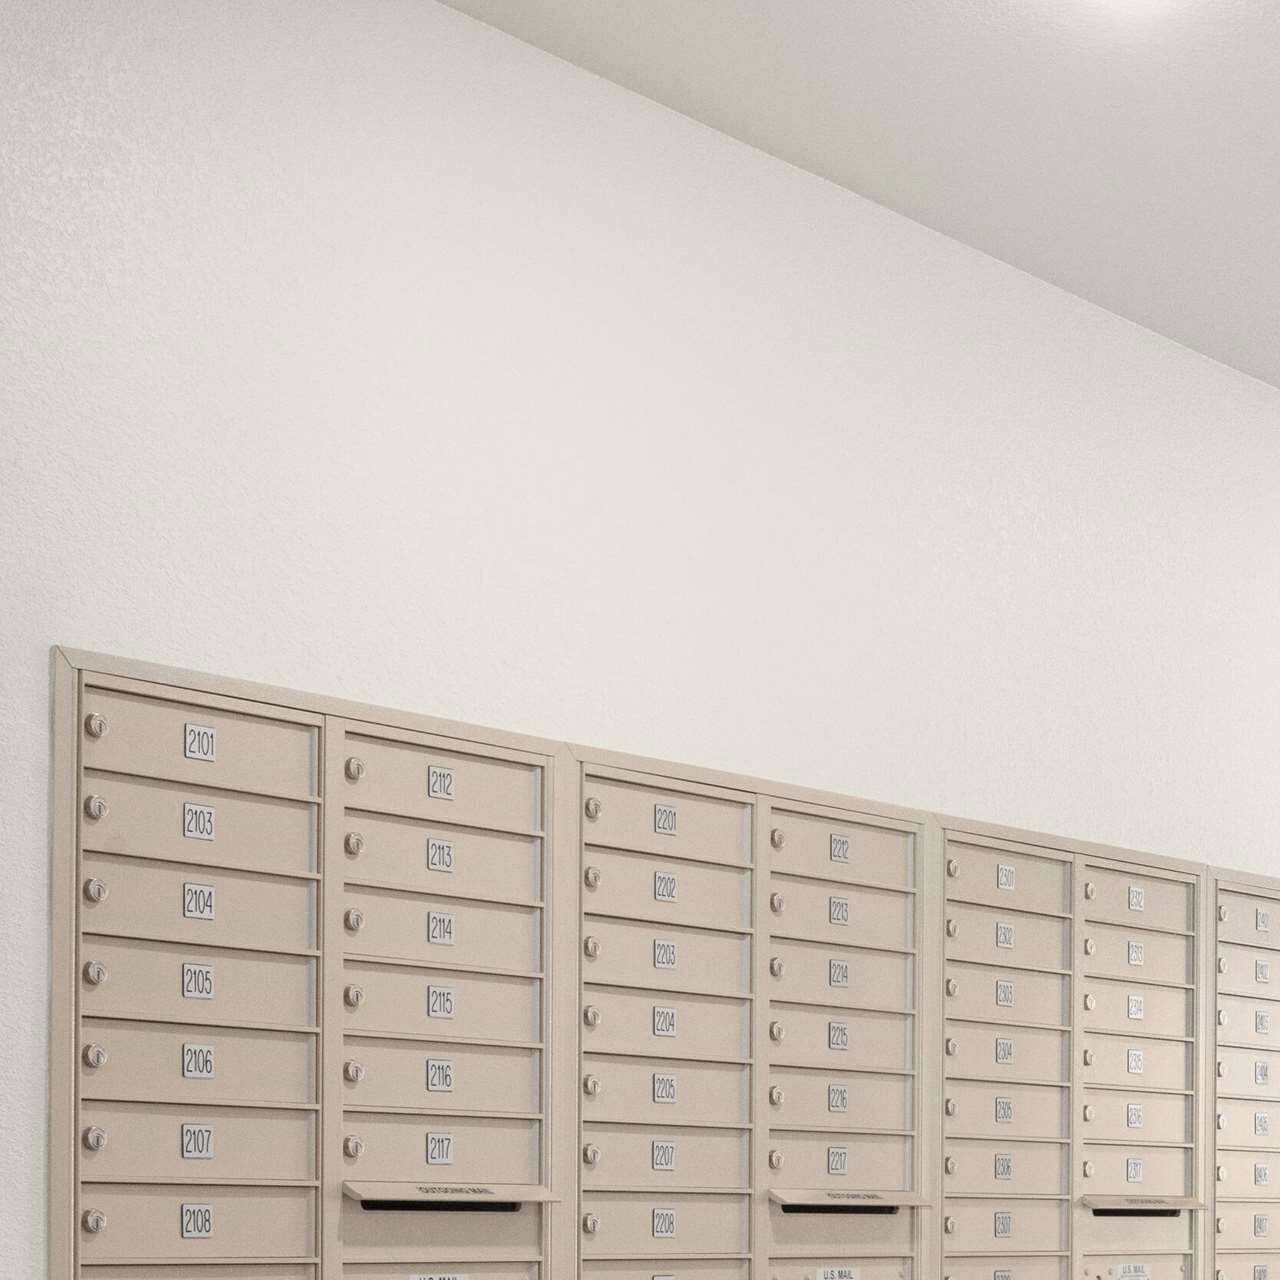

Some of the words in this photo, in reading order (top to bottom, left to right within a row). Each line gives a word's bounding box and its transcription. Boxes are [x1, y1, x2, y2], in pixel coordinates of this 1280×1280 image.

[188, 728, 215, 756] 2101
[431, 771, 453, 797] 2112
[186, 808, 213, 836] 2103
[657, 807, 677, 831] 2201
[430, 843, 452, 868] 2113
[832, 837, 849, 860] 2212
[656, 875, 676, 898] 2202
[999, 867, 1014, 888] 2301
[186, 888, 213, 915] 2104
[832, 901, 849, 923] 2213
[430, 915, 452, 941] 2114
[999, 926, 1013, 945] 2302
[656, 943, 676, 965] 2203
[185, 969, 212, 995] 2105
[831, 963, 848, 984] 2214
[430, 990, 453, 1014] 2115
[999, 983, 1012, 1004] 2303
[656, 1011, 675, 1033] 2204
[831, 1026, 848, 1046] 2215
[185, 1048, 213, 1074] 2106
[998, 1042, 1012, 1061] 2304
[429, 1064, 452, 1088] 2116
[656, 1077, 676, 1099] 2205
[831, 1088, 847, 1108] 2216
[997, 1101, 1012, 1119] 2305
[185, 1128, 212, 1154] 2107
[429, 1137, 451, 1161] 2117
[655, 1146, 674, 1166] 2207
[830, 1151, 847, 1170] 2217
[997, 1157, 1012, 1176] 2306
[184, 1208, 211, 1234] 2108
[655, 1213, 674, 1234] 2208
[997, 1216, 1011, 1234] 2307
[838, 1270, 854, 1280] MAIL
